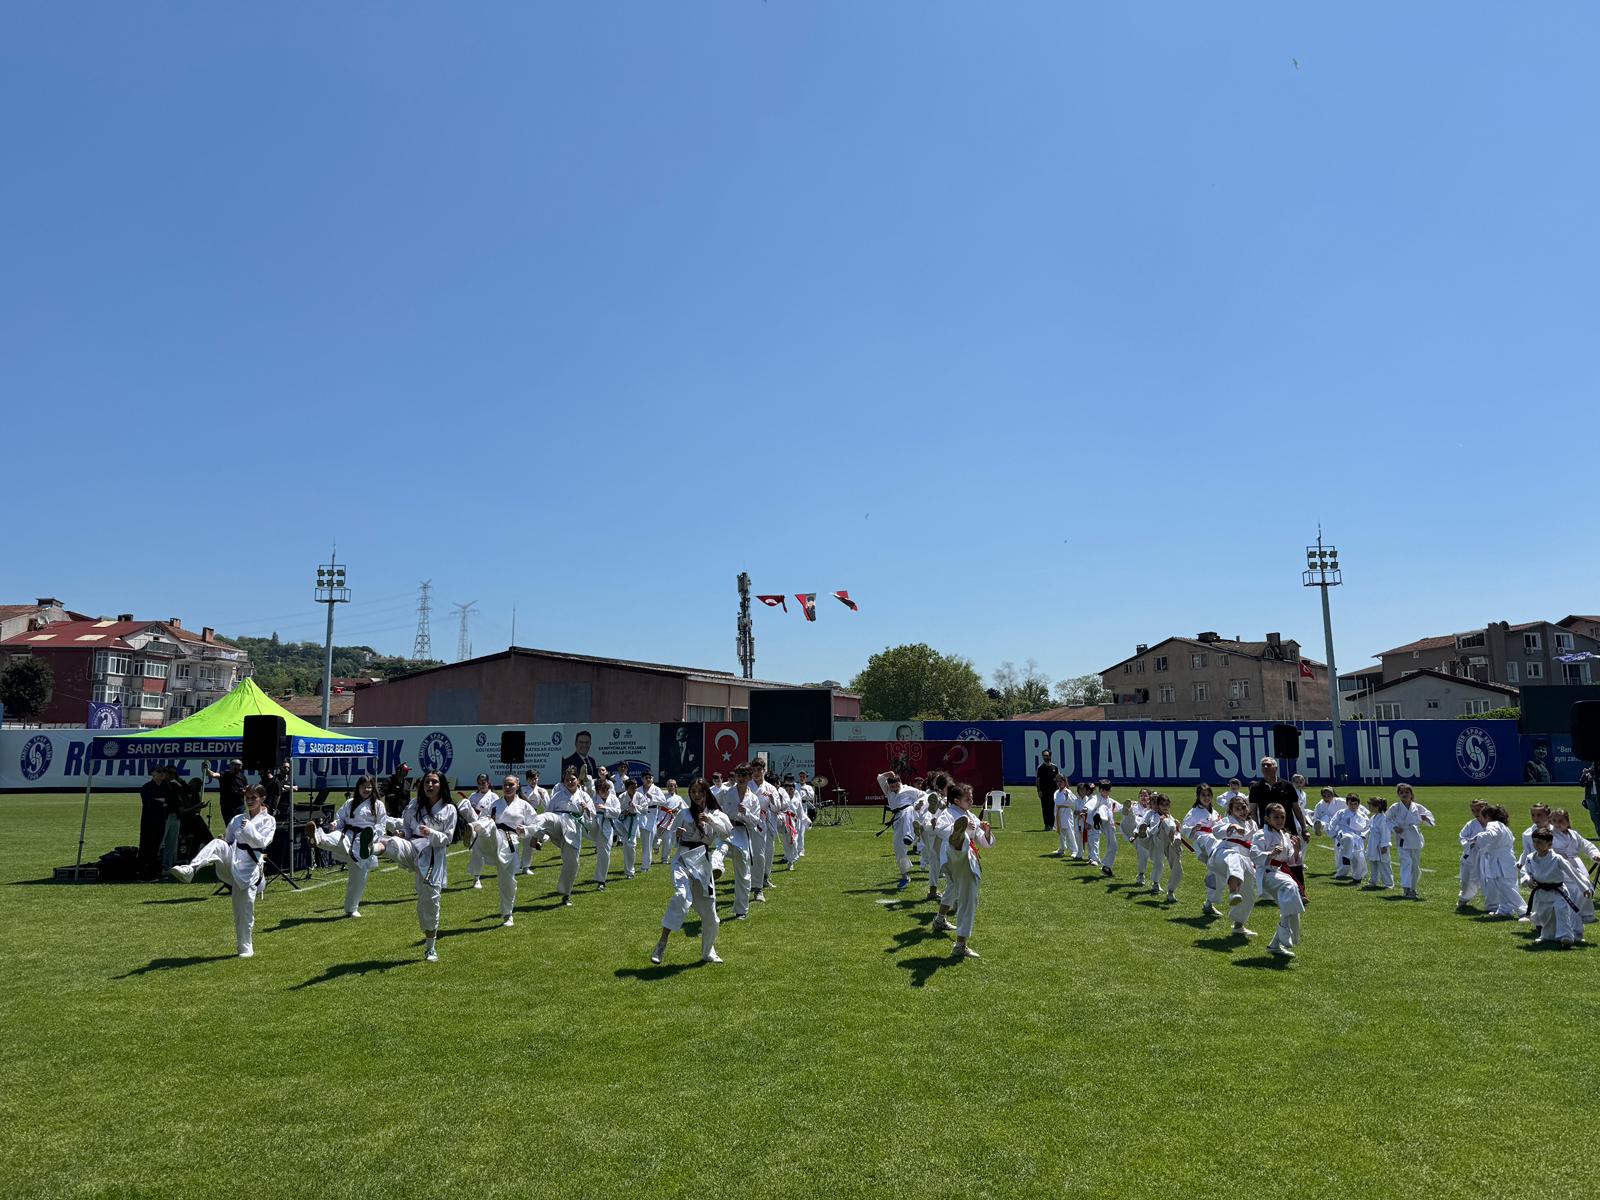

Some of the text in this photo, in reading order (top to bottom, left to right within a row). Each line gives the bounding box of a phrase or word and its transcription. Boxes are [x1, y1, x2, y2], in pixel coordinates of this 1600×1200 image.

[127, 741, 244, 754] SARIYER BELEDİYE
[309, 743, 335, 753] SARIYER
[1024, 730, 1200, 778] ROTAMIZ
[1213, 727, 1339, 778] SÜER
